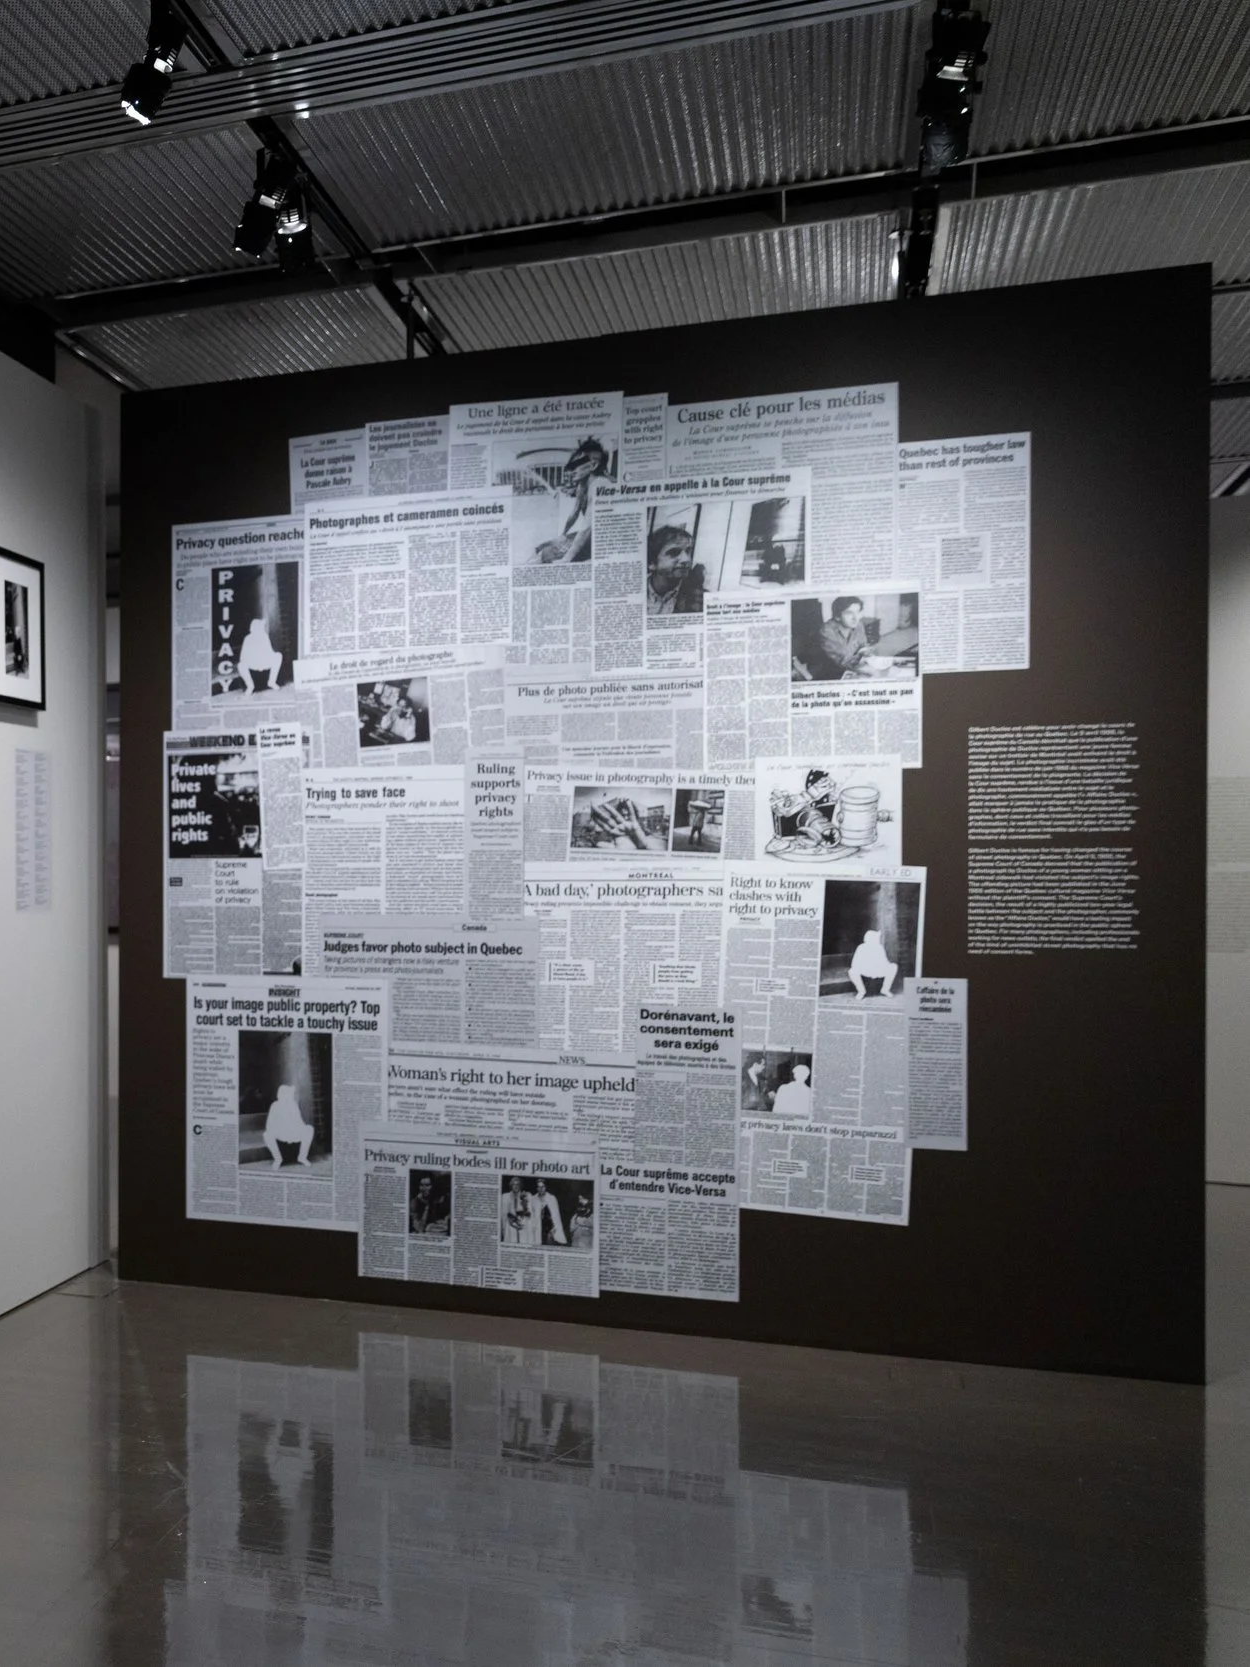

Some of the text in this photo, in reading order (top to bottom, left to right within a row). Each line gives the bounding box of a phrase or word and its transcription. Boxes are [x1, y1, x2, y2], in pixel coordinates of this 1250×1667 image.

[468, 398, 604, 419] Une ligne a été tracée
[678, 392, 885, 423] Cause clé pour les médias
[899, 439, 1025, 458] Quebec has tougher law
[899, 454, 1013, 471] than rest of provinces
[596, 473, 790, 496] Vice-Versa en appelle à la Cour suprême
[310, 504, 504, 529] Photographes et cameramen coincés
[176, 538, 215, 550] Privacy
[217, 533, 266, 549] question
[218, 570, 235, 693] PRIVACY
[518, 686, 540, 696] Plus
[542, 685, 555, 695] de
[557, 684, 587, 698] photo
[589, 682, 628, 696] publiée
[630, 683, 654, 691] sans
[172, 764, 215, 776] Private
[477, 764, 515, 777] Ruling
[172, 781, 201, 792] lives
[471, 778, 520, 792] supports
[527, 771, 563, 784] Privacy
[566, 772, 592, 781] issue
[594, 772, 604, 782] in
[607, 772, 674, 787] photography
[676, 774, 686, 783] is
[698, 774, 732, 788] timely
[306, 787, 405, 801] Trying to save face
[475, 793, 516, 806] privacy
[173, 797, 196, 809] and
[173, 813, 212, 829] public
[479, 807, 513, 820] rights
[173, 829, 208, 845] rights
[731, 877, 813, 890] Right to know
[535, 884, 560, 896] bad
[596, 884, 704, 900] photographers
[729, 891, 801, 902] clashes with
[729, 903, 817, 918] right to privacy
[324, 941, 522, 956] Judges favor photo subject in Quebec
[194, 997, 380, 1016] Is your image public property? Top
[196, 1015, 377, 1032] court set to tackle a touchy issue
[640, 1009, 734, 1025] Dorénavant, le
[640, 1025, 734, 1037] consentement
[654, 1039, 718, 1053] sera exigé
[559, 1056, 585, 1065] NEWS
[388, 1066, 634, 1095] Woman's right to her image upheld
[365, 1150, 590, 1175] Privacy ruling bodes ill for photo art
[601, 1164, 734, 1184] La Cour suprême accepte
[610, 1179, 725, 1197] d'entendre Vice-Versa
